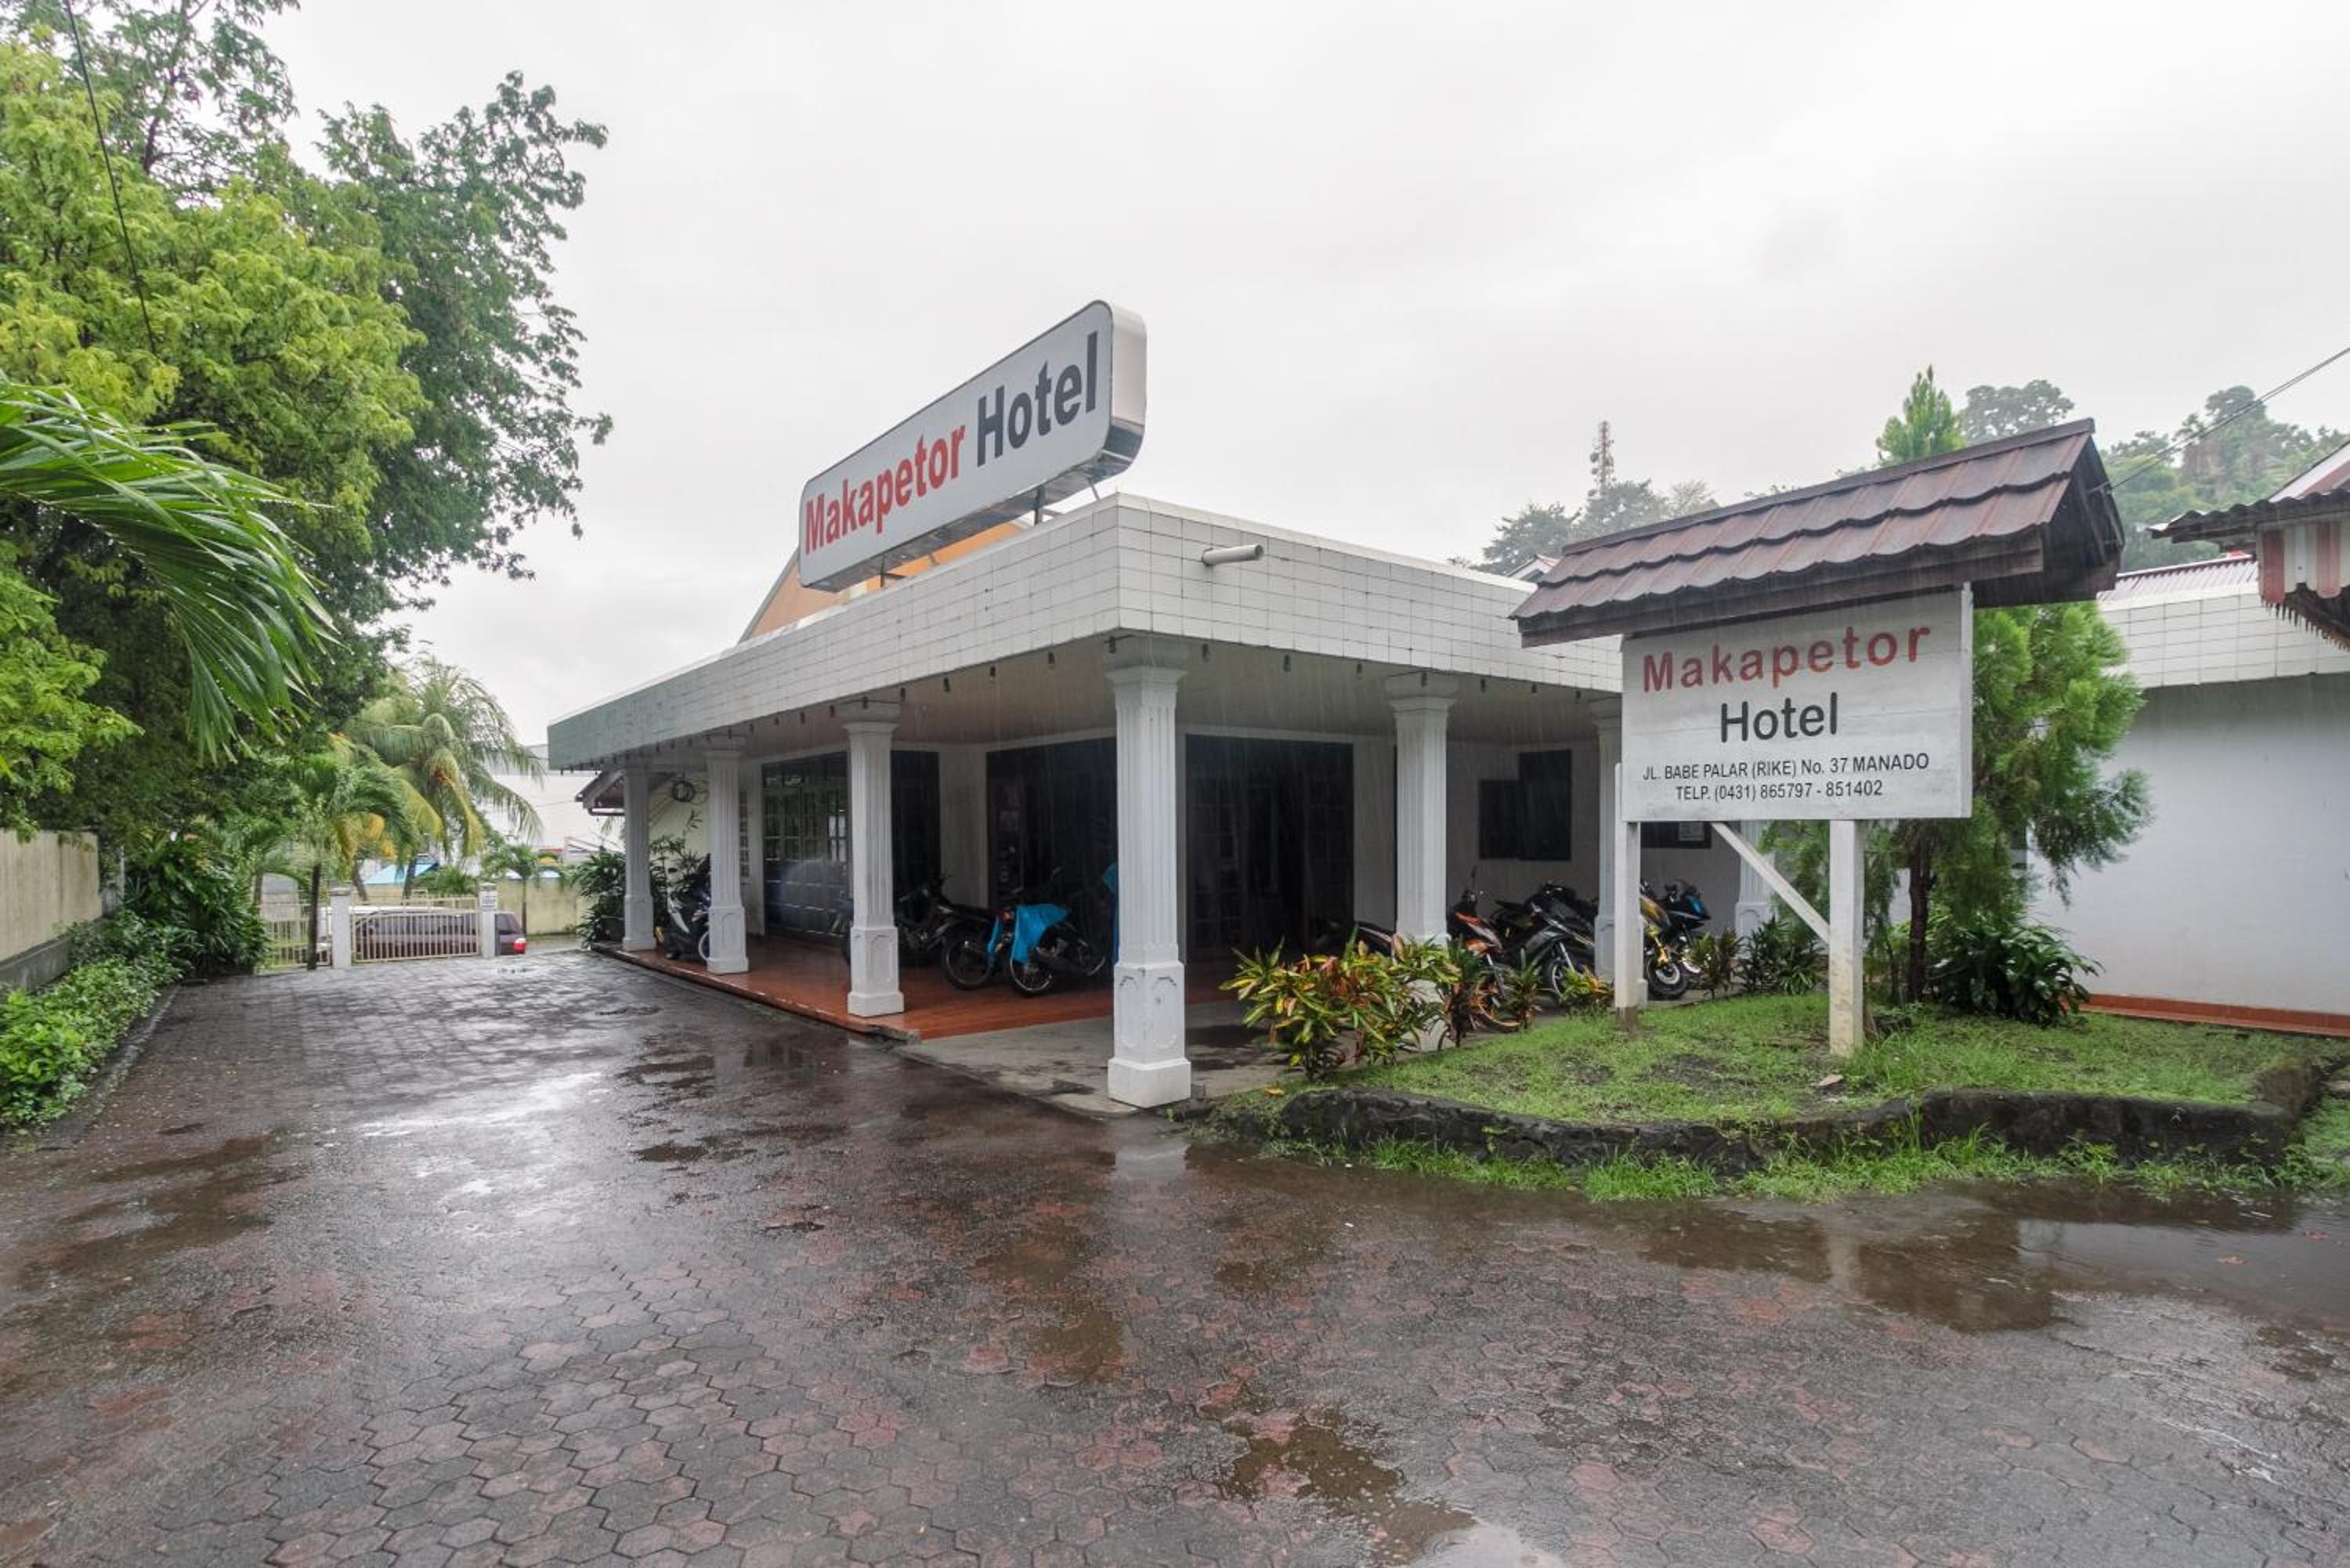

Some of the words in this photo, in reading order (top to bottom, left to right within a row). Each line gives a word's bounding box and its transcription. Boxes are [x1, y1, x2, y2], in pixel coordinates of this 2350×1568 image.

[804, 425, 966, 555] Makapetor
[976, 331, 1098, 468] Hotel
[1643, 626, 1931, 693] Makapetor
[1720, 692, 1838, 743] Hotel
[1643, 765, 1661, 781] JL.
[1665, 764, 1699, 779] BABE
[1703, 762, 1748, 779] PALAR
[1752, 760, 1796, 779] (RIKE)
[1801, 759, 1824, 775] No.
[1829, 757, 1848, 773] 37
[1853, 753, 1929, 772] MANADO
[1676, 786, 1711, 800] TELP.
[1714, 784, 1756, 803] (0431)
[1760, 782, 1813, 800] 865797
[1825, 779, 1883, 797] 851402
